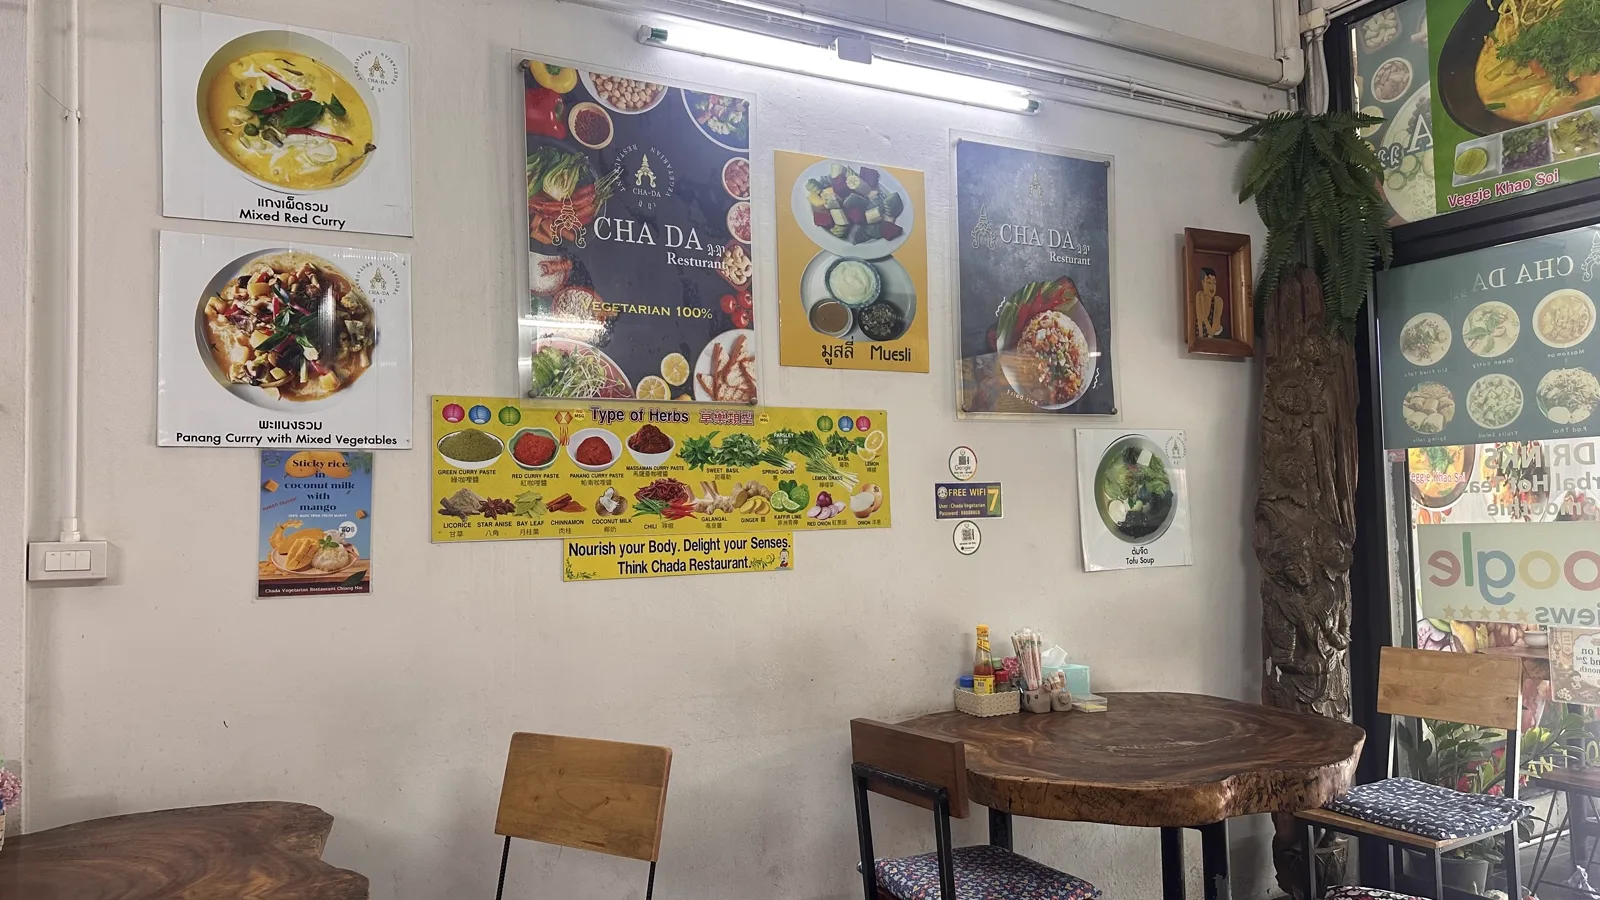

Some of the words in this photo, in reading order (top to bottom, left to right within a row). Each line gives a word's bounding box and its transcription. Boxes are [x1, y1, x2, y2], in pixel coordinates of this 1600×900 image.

[632, 188, 661, 197] CHA-DA
[1448, 188, 1491, 208] Veggie
[1495, 178, 1531, 196] Khao
[1535, 168, 1559, 186] Soi
[257, 196, 328, 212] แกงเผ็ดรวม
[239, 209, 280, 222] Mixed
[284, 213, 308, 224] Red
[312, 215, 346, 230] Curry
[593, 216, 656, 246] CHA
[664, 224, 704, 250] DA
[1000, 223, 1042, 247] CHA
[1047, 228, 1075, 250] DA
[667, 252, 727, 270] Resturant
[1049, 251, 1091, 266] Resturant
[582, 299, 671, 316] VEGETARIAN
[677, 306, 713, 319] 100%
[821, 336, 854, 366] มูสลี่
[870, 344, 911, 362] Muesli
[1006, 389, 1024, 401] Fried
[1025, 398, 1039, 406] rice
[590, 407, 625, 424] Type
[631, 408, 644, 422] of
[650, 408, 689, 423] Herbs
[176, 433, 221, 445] Panang
[225, 434, 263, 446] Currry
[267, 433, 292, 444] with
[296, 434, 332, 444] Mixed
[335, 435, 397, 447] Vegetables
[292, 459, 326, 468] Sticky
[328, 460, 348, 468] rice
[331, 481, 355, 489] milk
[300, 504, 337, 512] mango
[948, 489, 967, 497] FREE
[970, 488, 986, 496] WIFI
[988, 488, 999, 512] 7
[568, 542, 616, 557] Nourish
[620, 543, 646, 558] your
[648, 540, 680, 556] Body.
[683, 538, 720, 555] Delight
[724, 539, 747, 555] your
[750, 536, 791, 549] Senses.
[617, 561, 648, 575] Think
[651, 559, 686, 573] Chada
[689, 556, 751, 571] Restaurant.
[1126, 557, 1138, 565] Tofu
[1140, 556, 1155, 565] Soup
